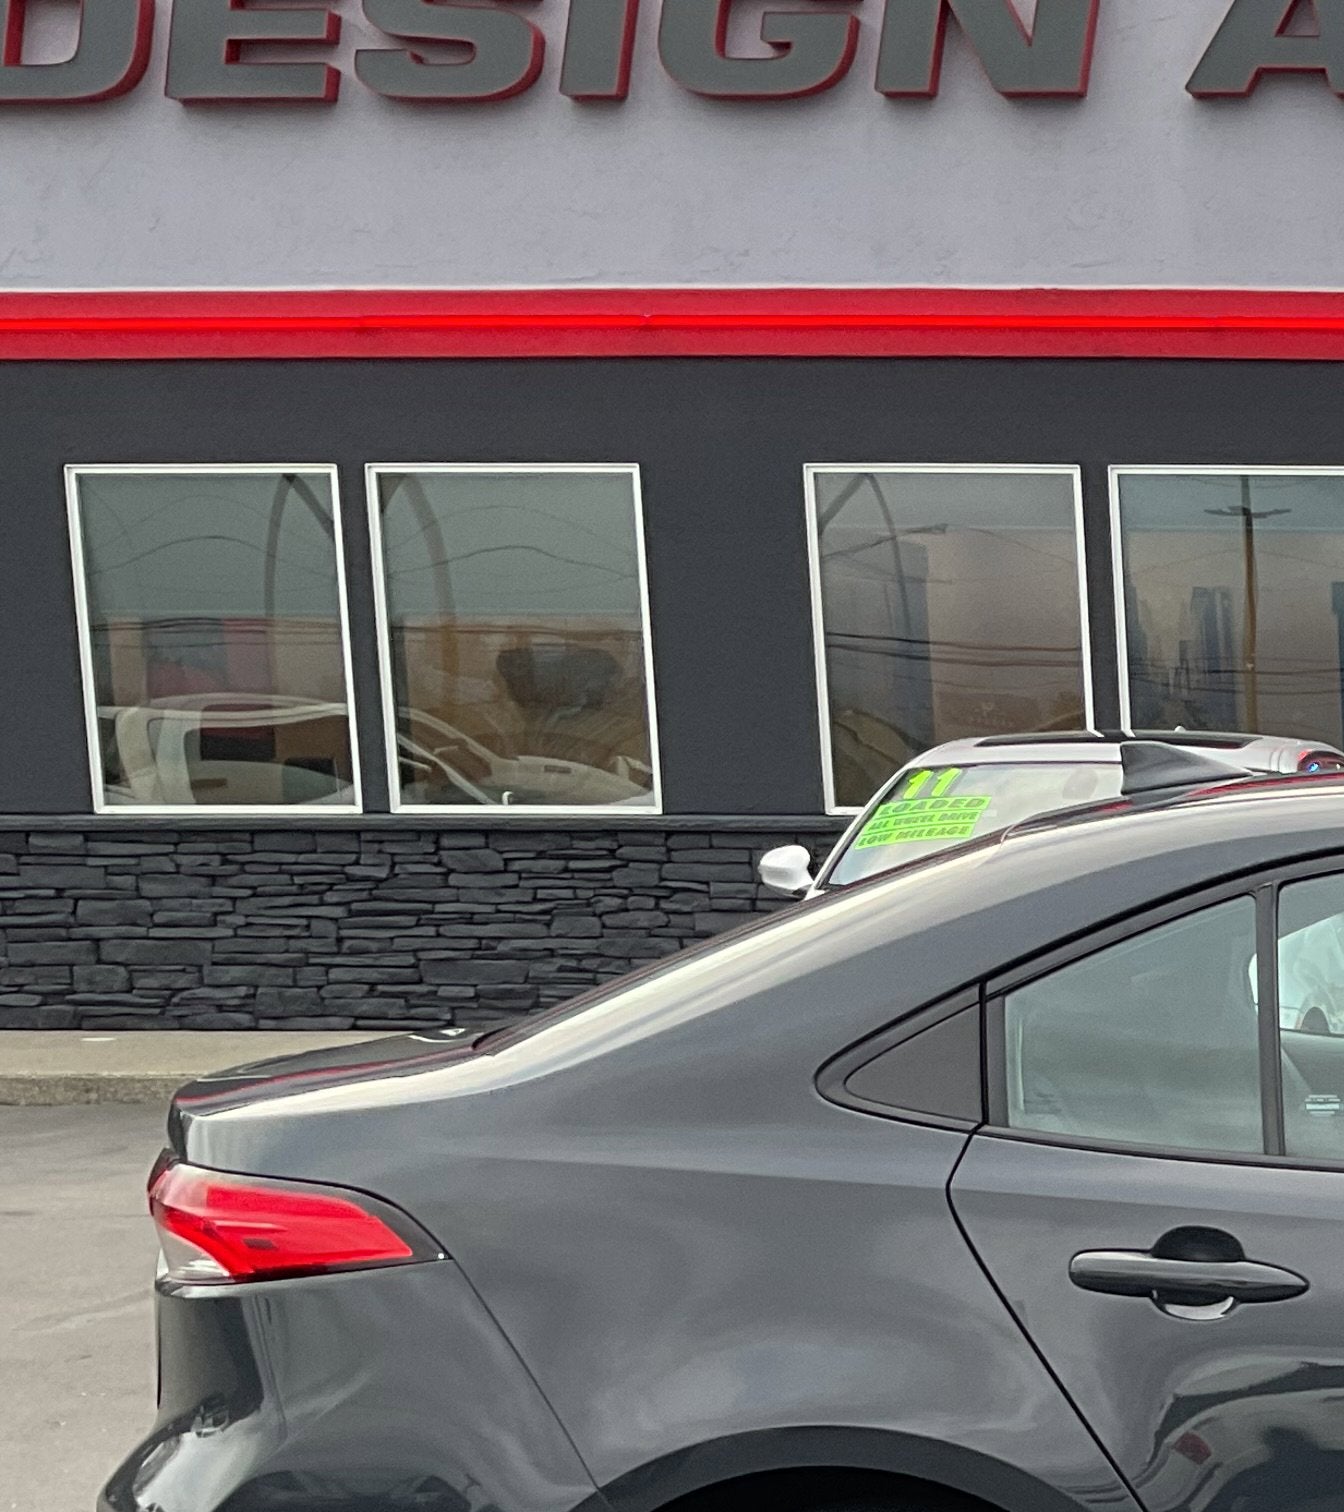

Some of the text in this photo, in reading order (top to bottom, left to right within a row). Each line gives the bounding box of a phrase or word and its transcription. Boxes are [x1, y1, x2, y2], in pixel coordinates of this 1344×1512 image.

[0, 0, 1096, 104] DESIGN
[903, 768, 962, 799] 11
[879, 799, 985, 816] LOADED
[858, 826, 969, 846] LOW MILEAGE
